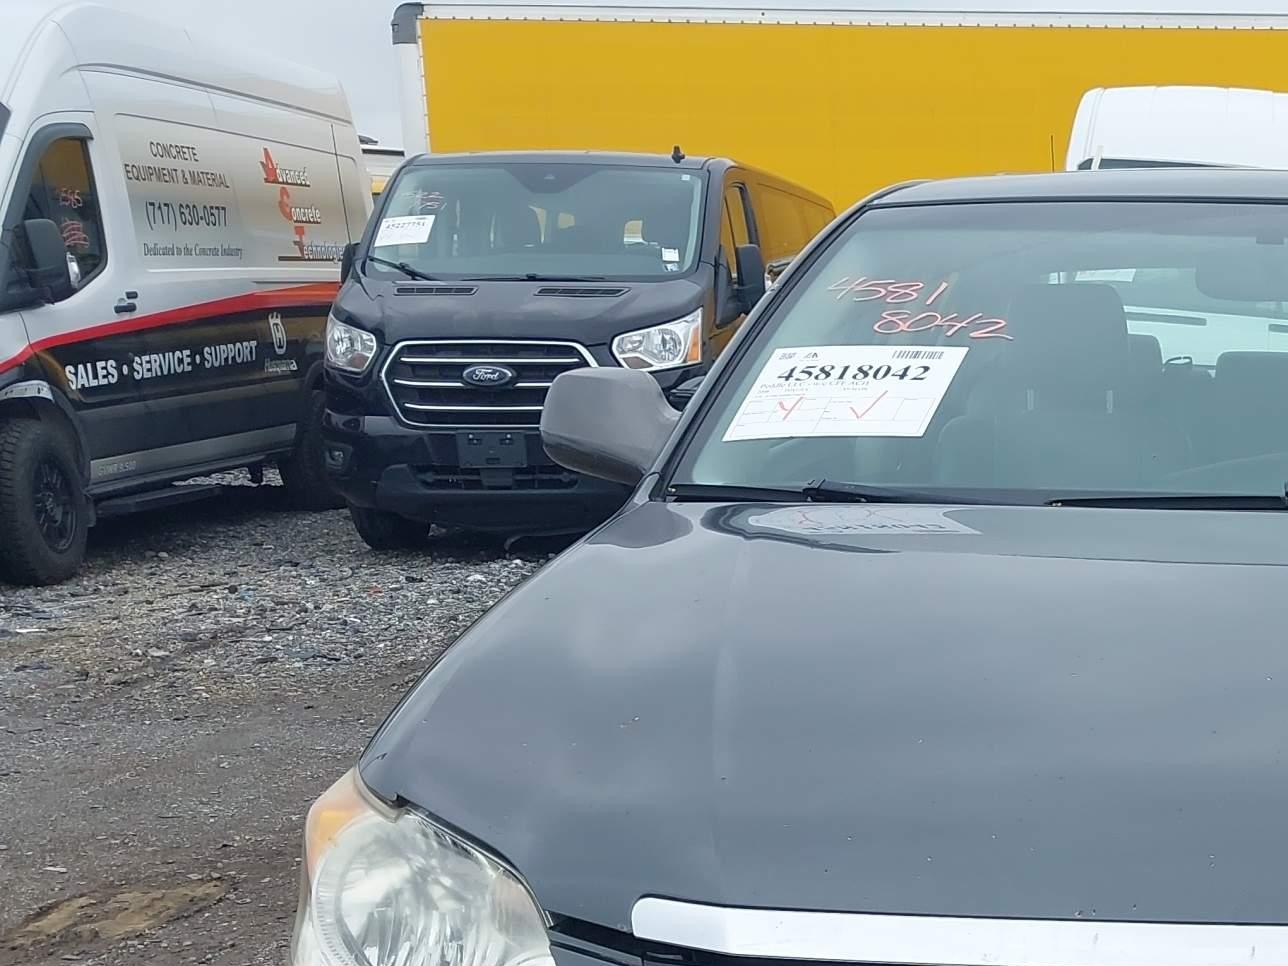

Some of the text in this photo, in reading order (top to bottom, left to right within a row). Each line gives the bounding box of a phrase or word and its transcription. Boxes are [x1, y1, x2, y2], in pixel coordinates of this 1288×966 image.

[149, 140, 200, 163] CONCRETE
[123, 163, 231, 190] EQUIPMENT & MATERIAL
[259, 147, 311, 188] Advanced
[145, 201, 228, 232] (717) 630-0577
[278, 186, 322, 224] Concrete
[143, 242, 243, 260] Dedicated to the Concrete Industry
[826, 276, 949, 305] 4581
[872, 309, 1014, 341] 8042
[64, 340, 258, 390] SALES SERVICE SUPPORT
[472, 368, 500, 381] Ford
[776, 364, 931, 382] 45818042
